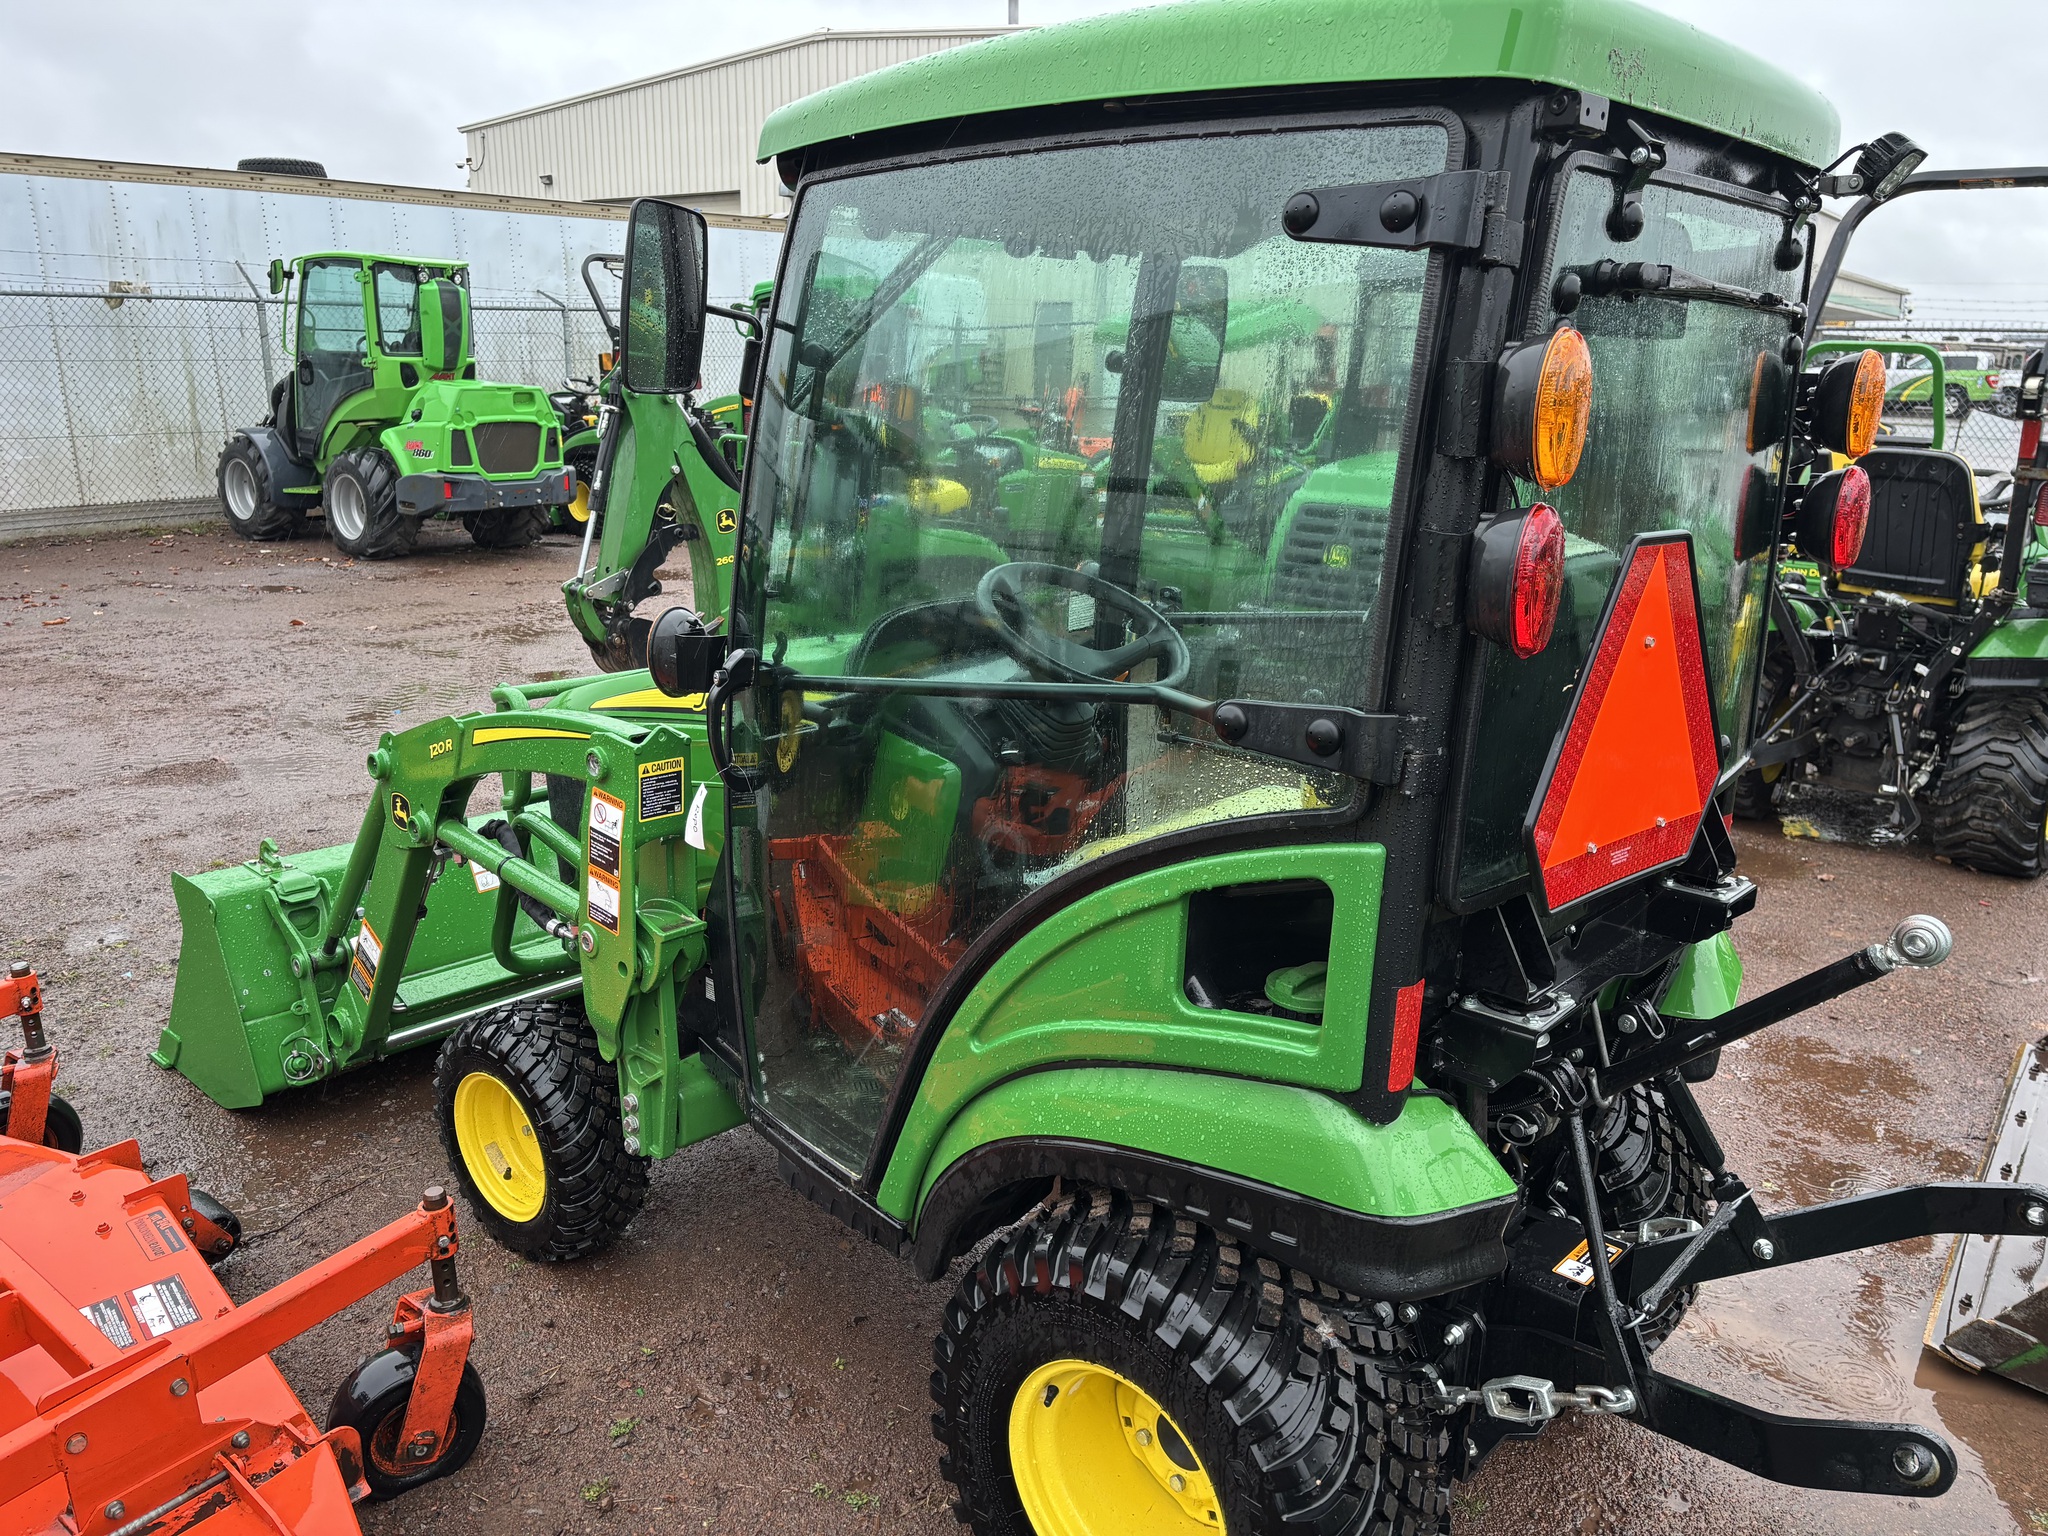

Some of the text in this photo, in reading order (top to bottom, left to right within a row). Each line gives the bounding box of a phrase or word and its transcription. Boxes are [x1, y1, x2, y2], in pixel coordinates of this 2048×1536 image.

[652, 759, 682, 772] CAUTION
[598, 792, 623, 809] WARNING
[594, 870, 619, 889] WARNING
